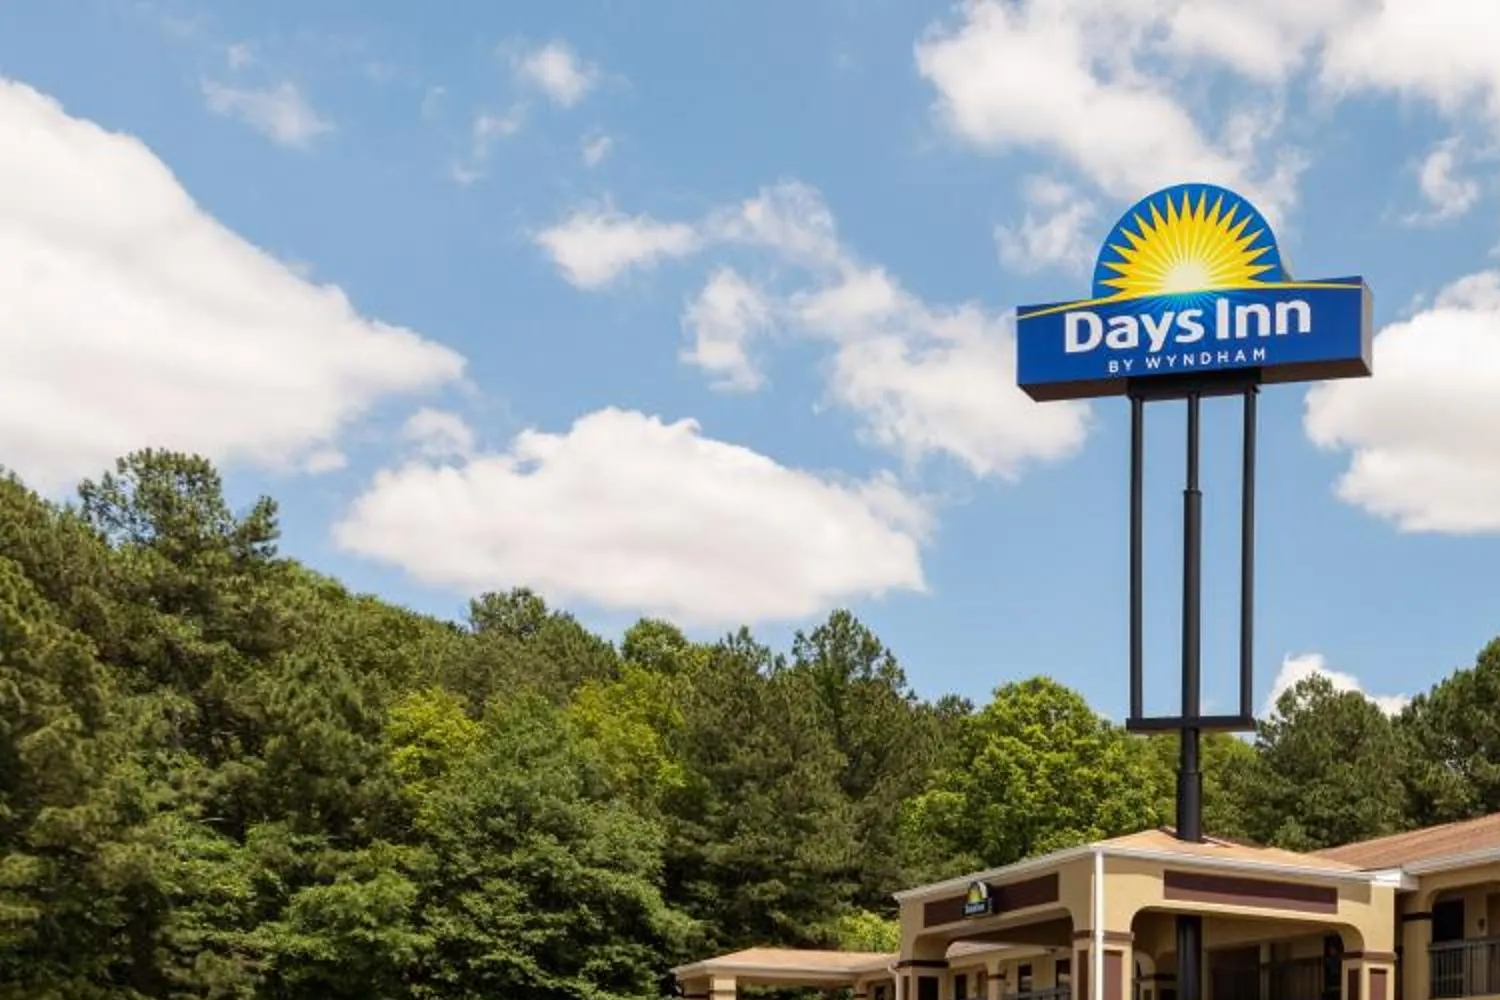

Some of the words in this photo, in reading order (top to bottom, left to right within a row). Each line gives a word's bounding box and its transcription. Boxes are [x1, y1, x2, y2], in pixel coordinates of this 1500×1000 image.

[1064, 309, 1205, 353] Days
[1216, 298, 1311, 339] Inn
[1109, 359, 1134, 373] BY
[1145, 346, 1266, 369] WYNDHAM
